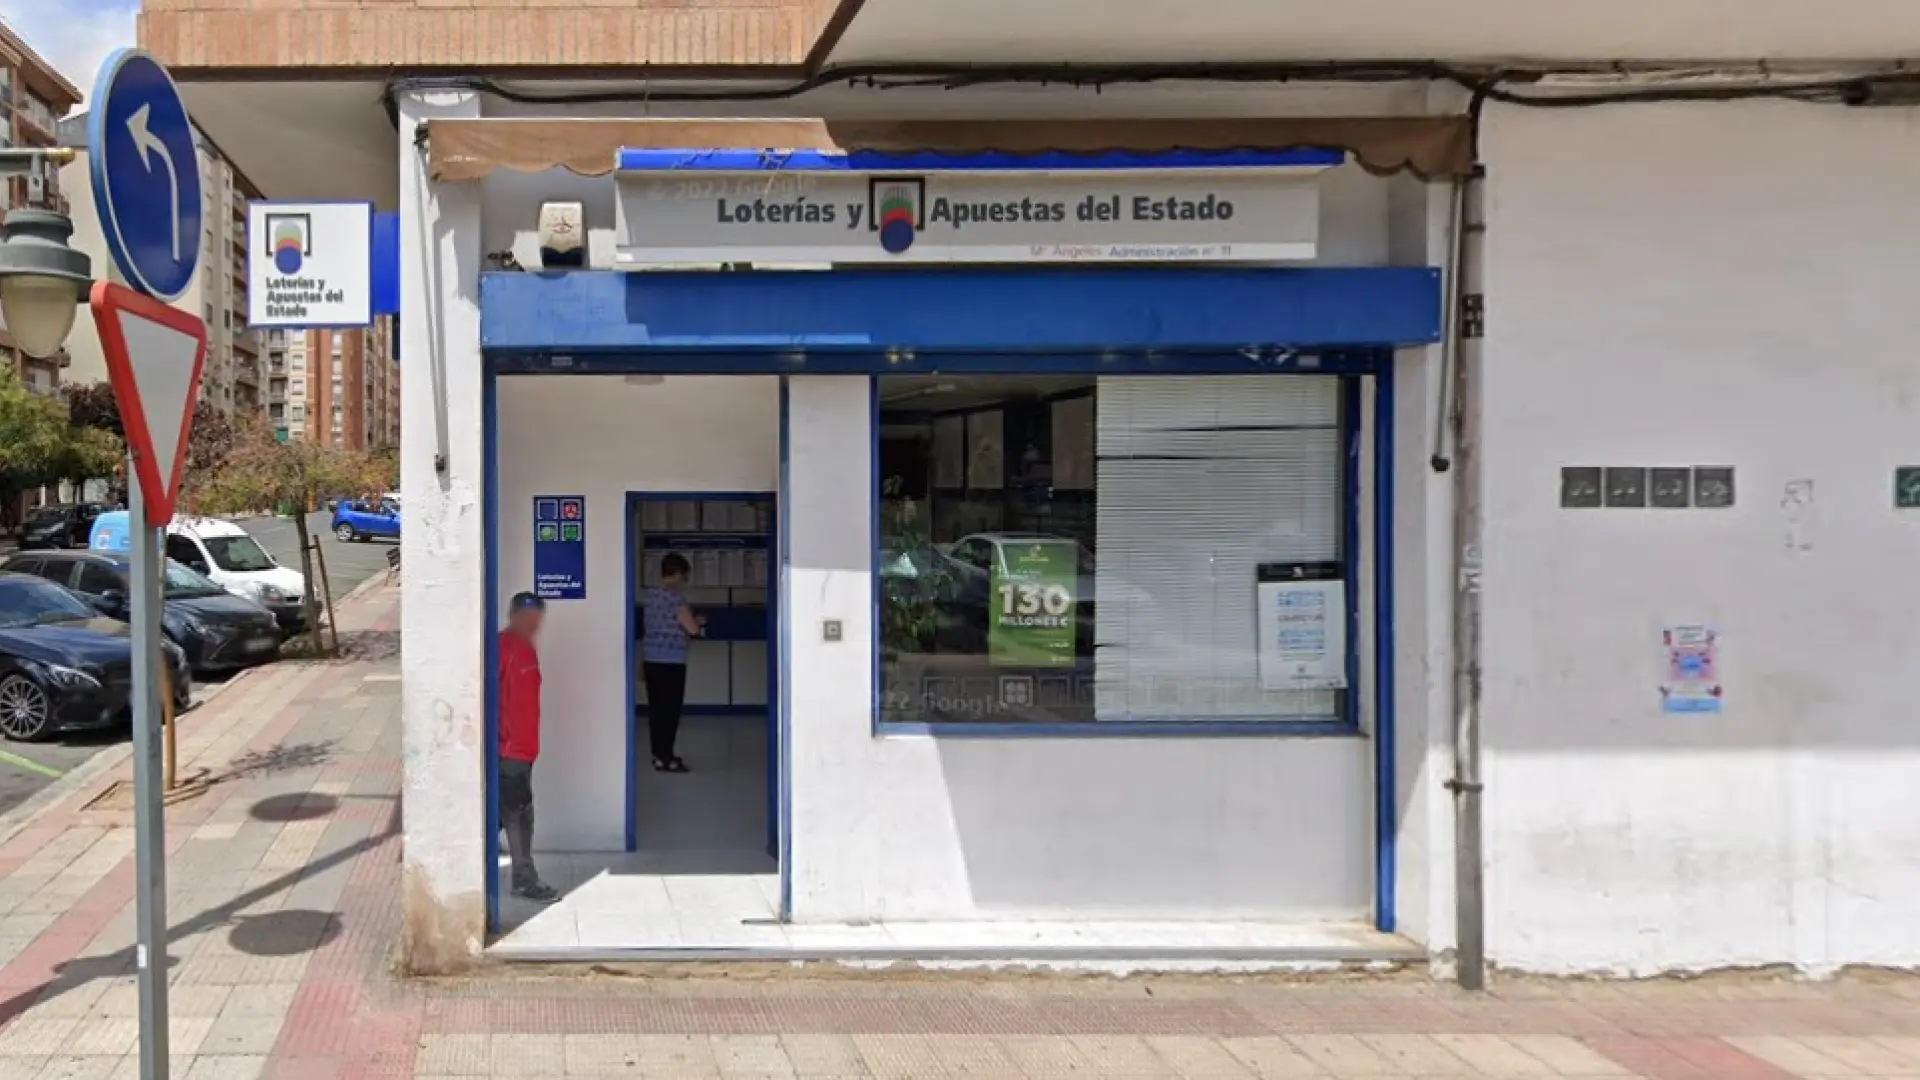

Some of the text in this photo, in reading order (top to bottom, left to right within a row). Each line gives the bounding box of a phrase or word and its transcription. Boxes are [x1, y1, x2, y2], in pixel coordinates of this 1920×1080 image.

[717, 194, 1233, 229] Loterías y Apuestas del Estado
[318, 279, 326, 291] y
[266, 289, 343, 304] Apuestas del
[266, 303, 307, 317] Estado
[998, 584, 1070, 615] 130
